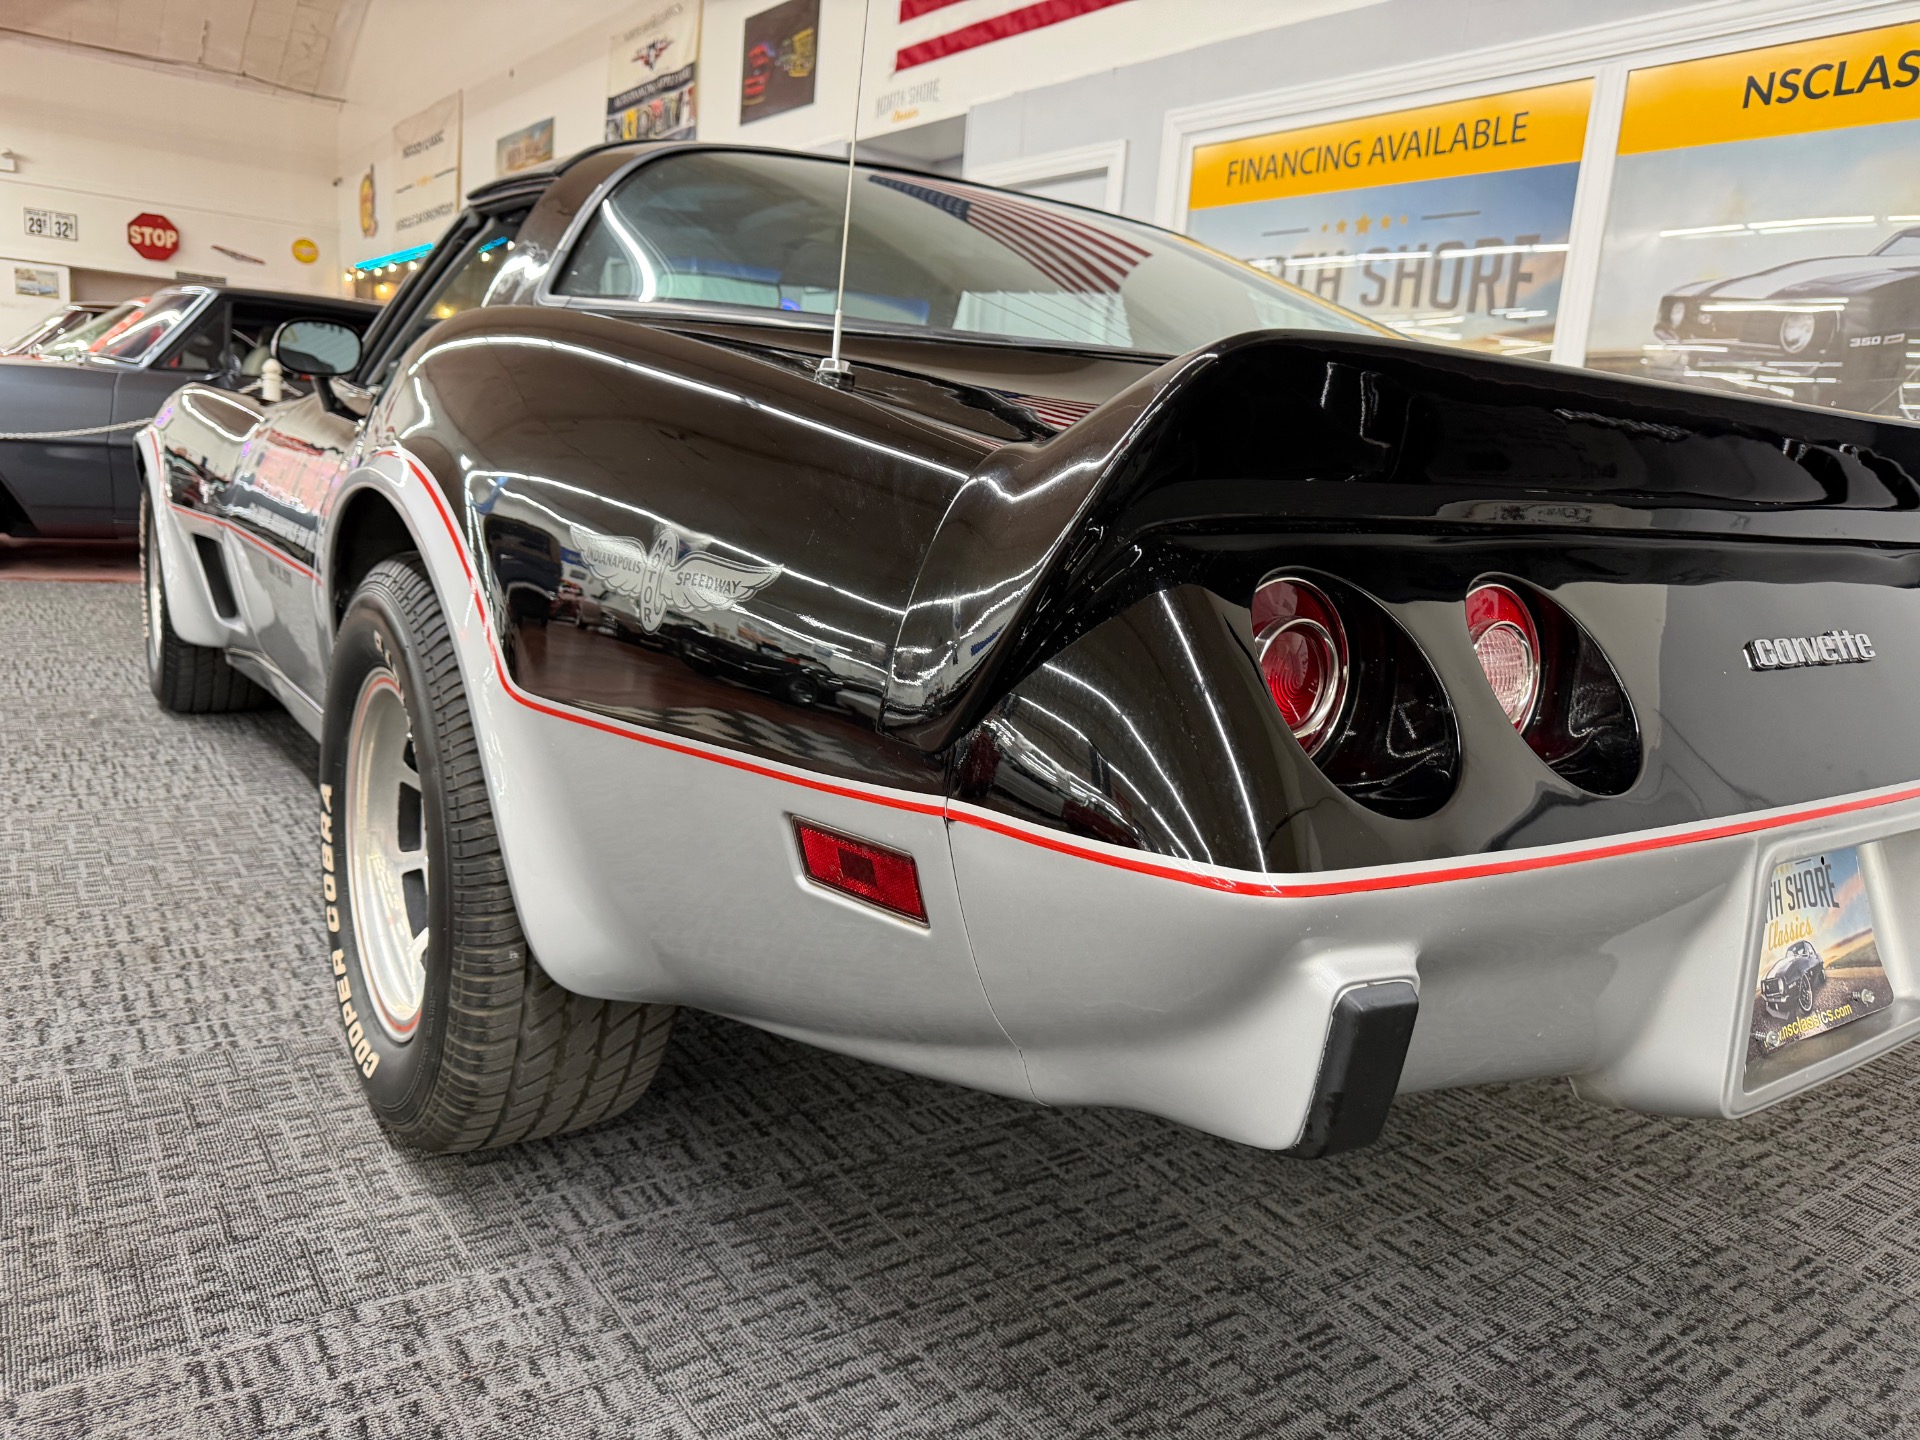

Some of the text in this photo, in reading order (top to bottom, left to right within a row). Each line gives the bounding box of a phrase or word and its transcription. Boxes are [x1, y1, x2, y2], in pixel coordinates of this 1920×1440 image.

[1742, 49, 1920, 109] NSCLAS
[1226, 111, 1530, 187] FINANCING AVAILABLE
[129, 225, 178, 249] STOP
[586, 546, 642, 574] INDIANAPOLIS
[675, 571, 742, 594] SPEEDWAY
[1785, 864, 1840, 911] SHORE
[320, 783, 380, 1079] COOPER COBRA
[1767, 916, 1813, 952] Classics
